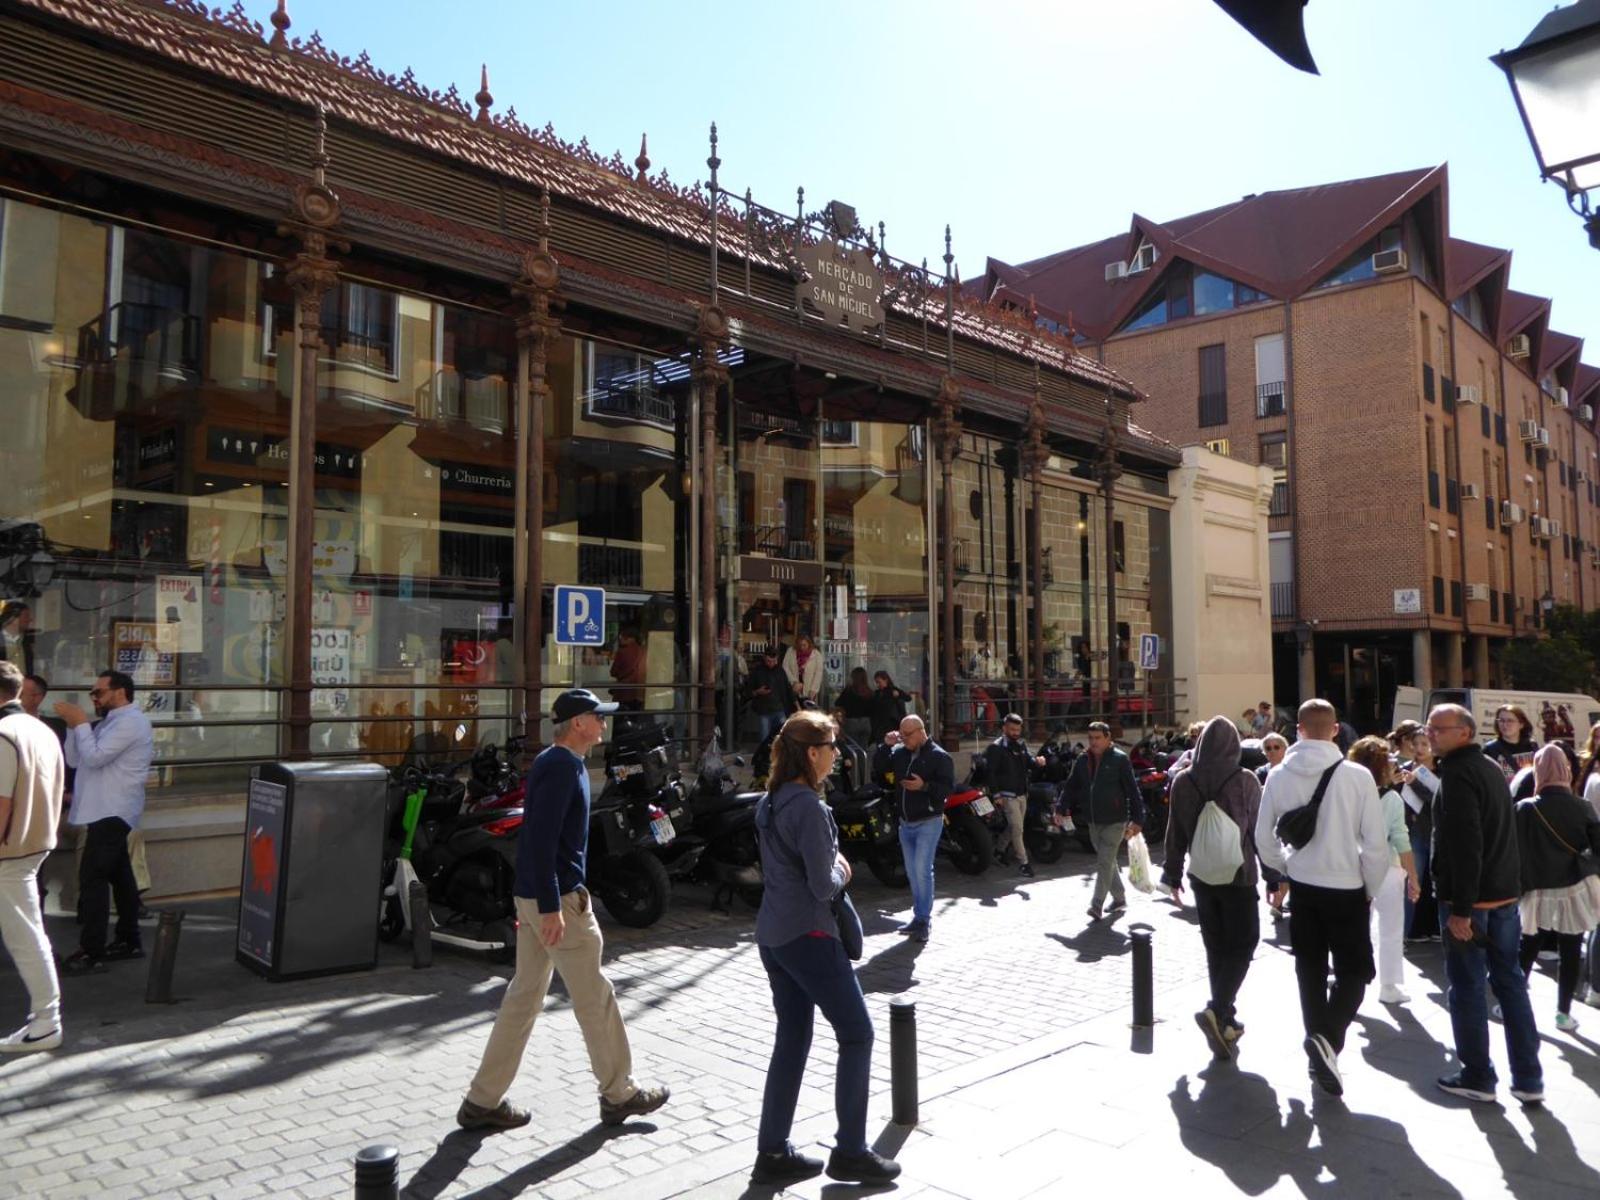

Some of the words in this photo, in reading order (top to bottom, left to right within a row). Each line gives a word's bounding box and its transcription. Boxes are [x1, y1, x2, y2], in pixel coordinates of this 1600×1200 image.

[818, 259, 872, 289] MERCADO
[839, 282, 854, 295] DE
[813, 286, 835, 306] SAN
[567, 591, 590, 637] P
[1143, 637, 1152, 666] P
